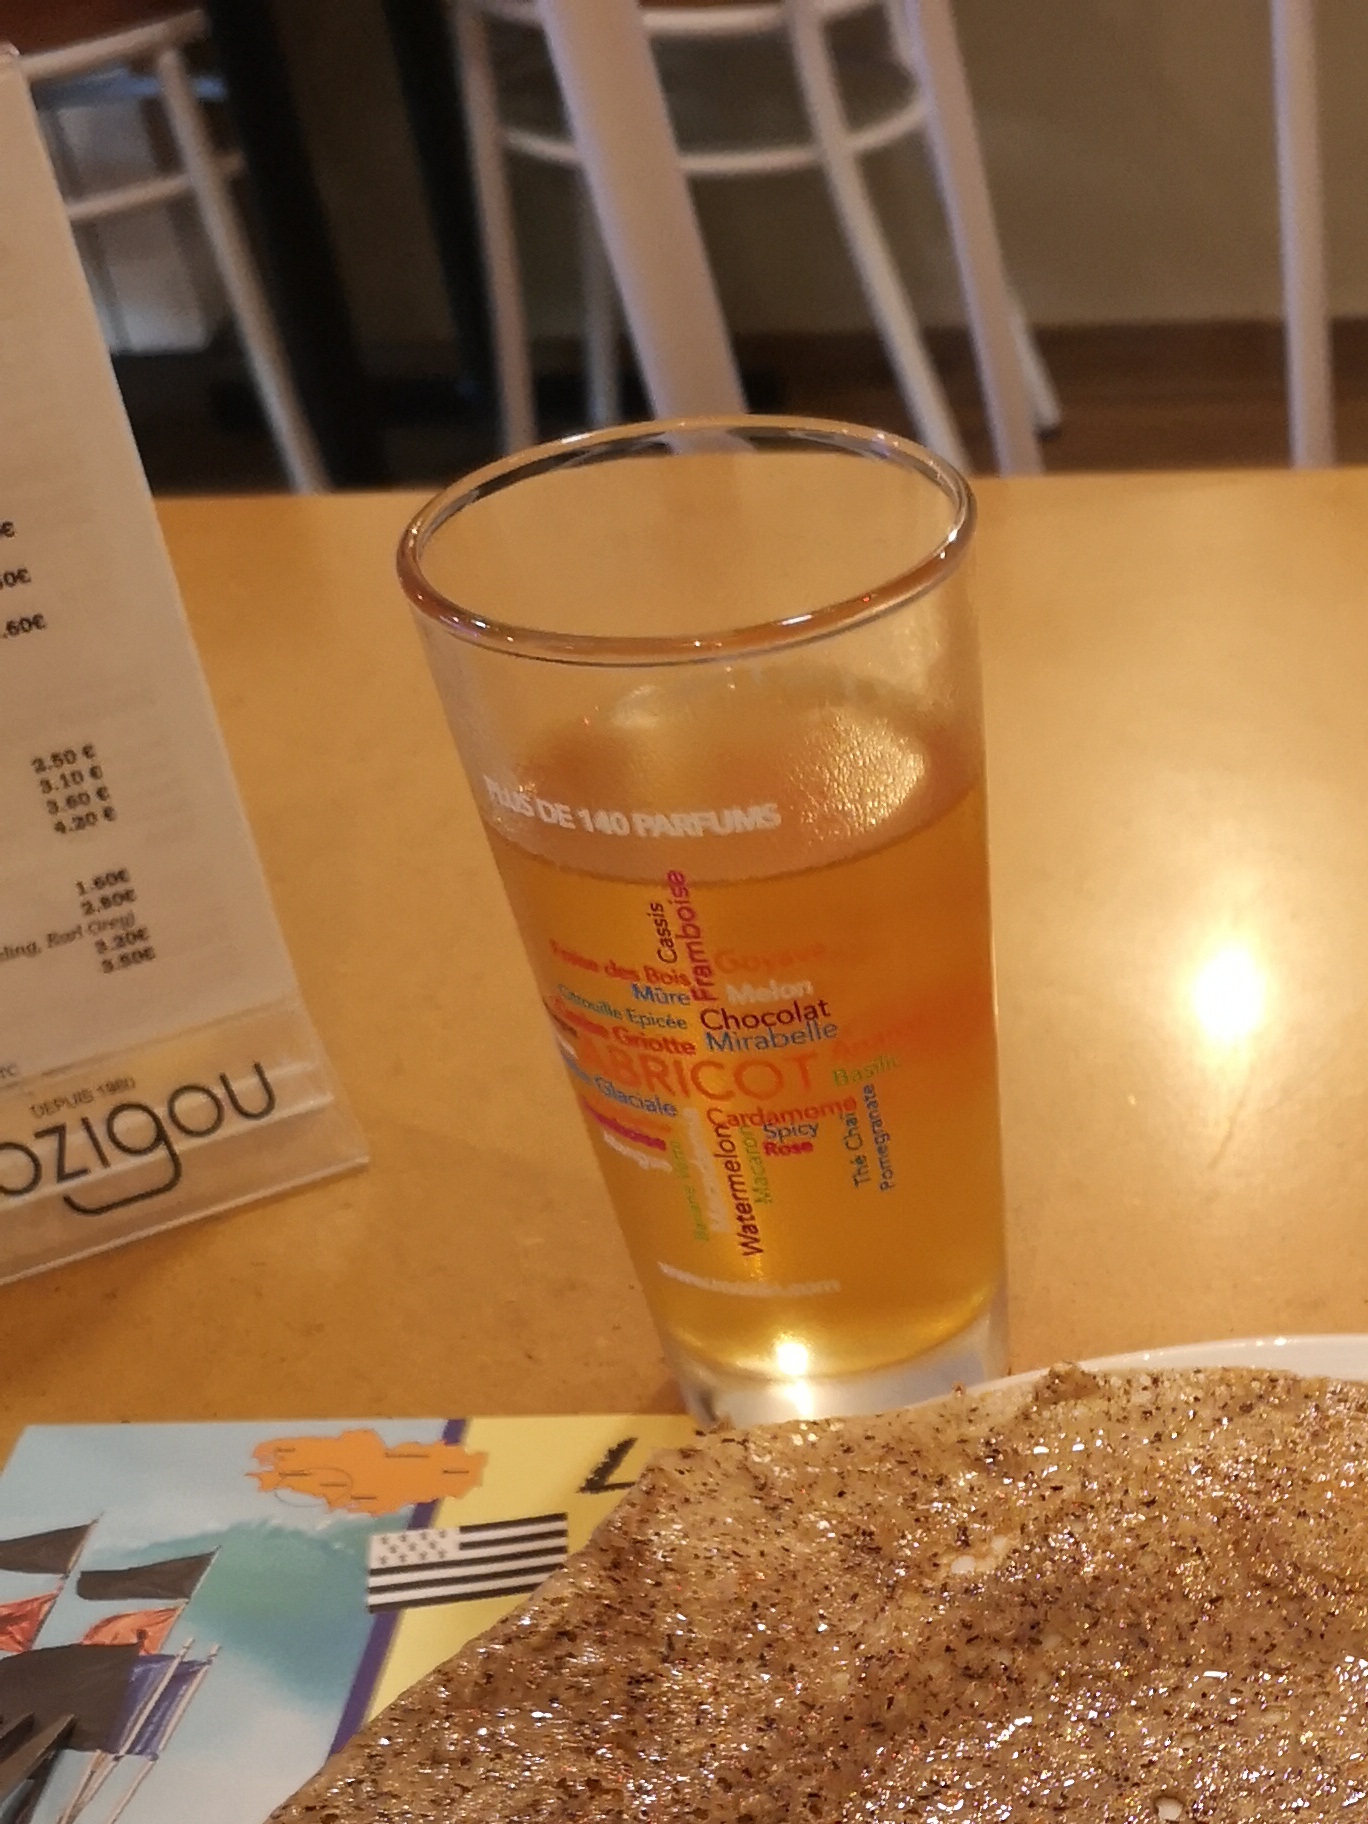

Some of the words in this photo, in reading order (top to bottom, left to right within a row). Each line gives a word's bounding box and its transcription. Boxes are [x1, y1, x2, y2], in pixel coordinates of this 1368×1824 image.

[537, 799, 576, 830] DE
[577, 807, 631, 836] 140
[632, 803, 782, 837] PARFUMS
[647, 902, 678, 964] Cassis
[667, 870, 717, 1003] Framboise
[644, 965, 692, 987] Bois
[725, 978, 814, 1005] Melon
[700, 999, 831, 1030] Chocolat
[613, 1027, 696, 1056] Griotte
[705, 1020, 838, 1052] Mirabelle
[579, 1036, 818, 1101] ABRICOT
[594, 1075, 678, 1118] Glaciale
[763, 1121, 819, 1144] Spicy
[763, 1140, 814, 1157] Rose
[863, 1083, 895, 1193] Pomegranate
[713, 1122, 764, 1257] Watermelon
